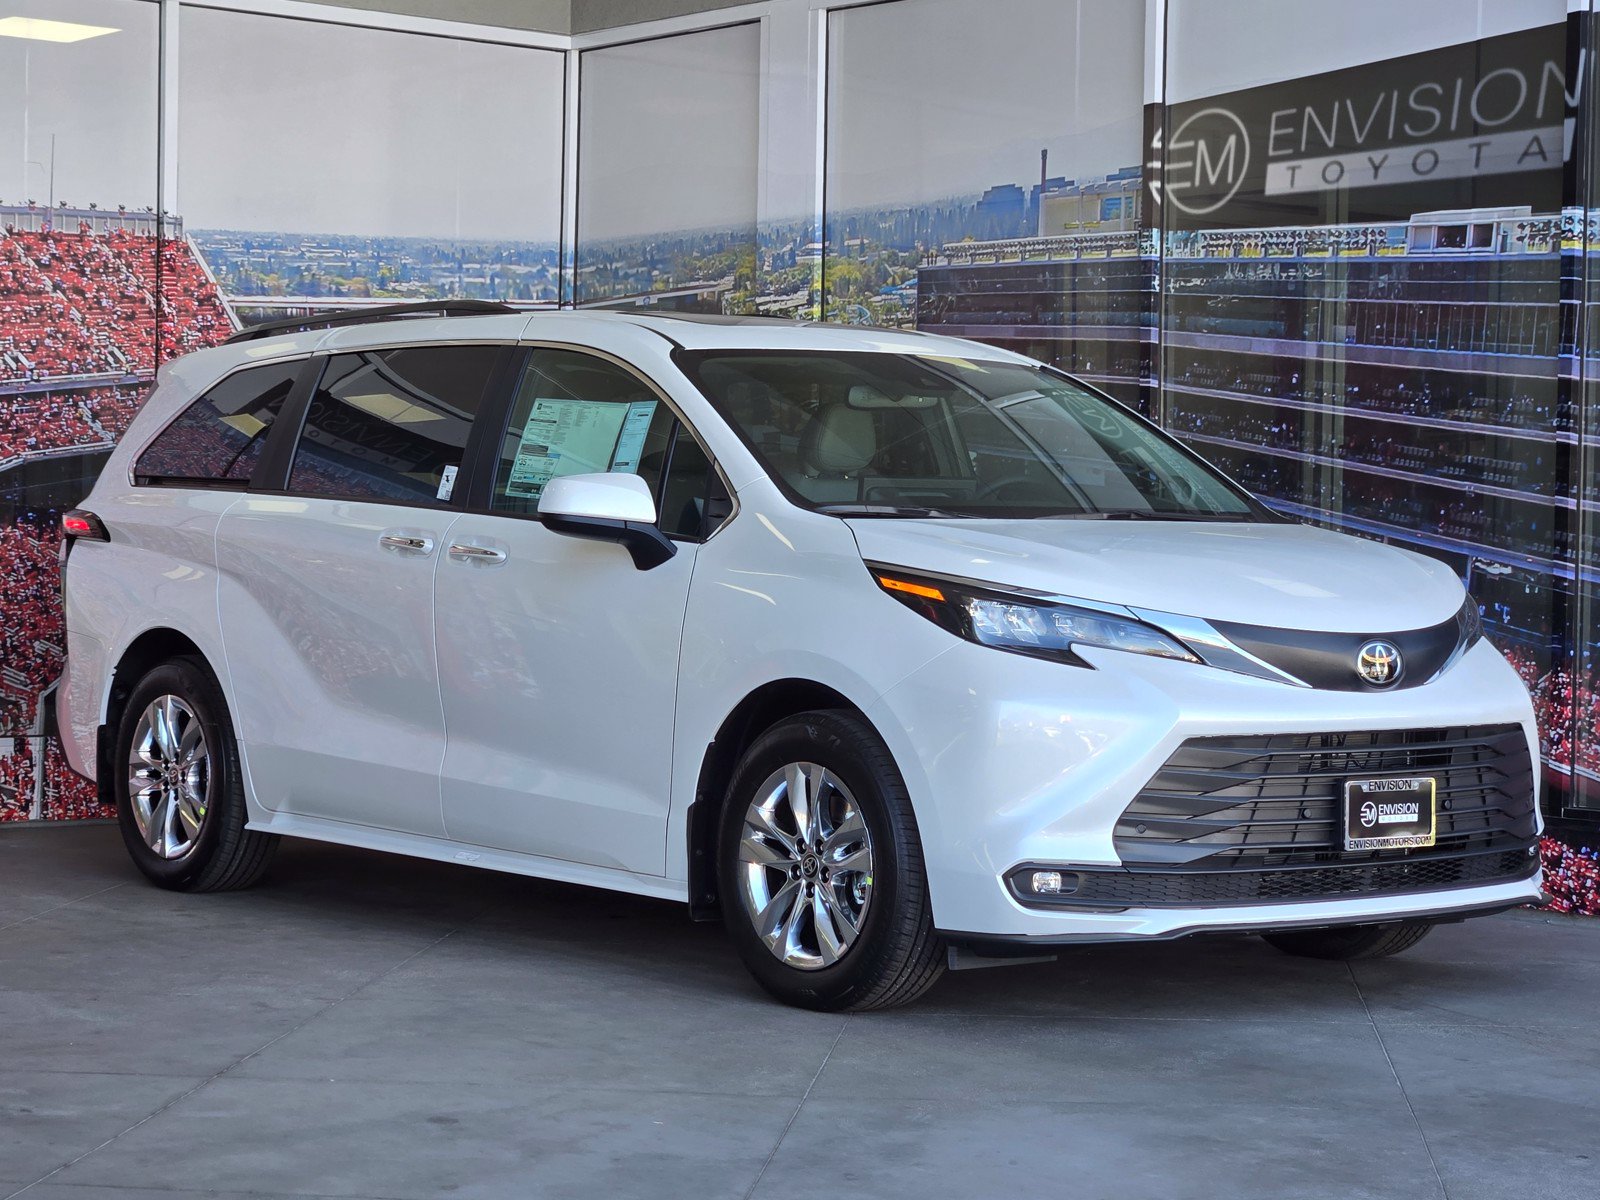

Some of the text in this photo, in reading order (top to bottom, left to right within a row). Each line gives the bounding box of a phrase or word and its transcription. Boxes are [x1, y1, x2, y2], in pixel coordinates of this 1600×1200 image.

[1268, 47, 1586, 156] ENVISION
[1285, 134, 1549, 189] TOYOTA
[1368, 780, 1412, 791] ENVISION
[1378, 803, 1419, 815] ENVISION
[1349, 836, 1432, 849] ENVISIONMOTORS.COM
